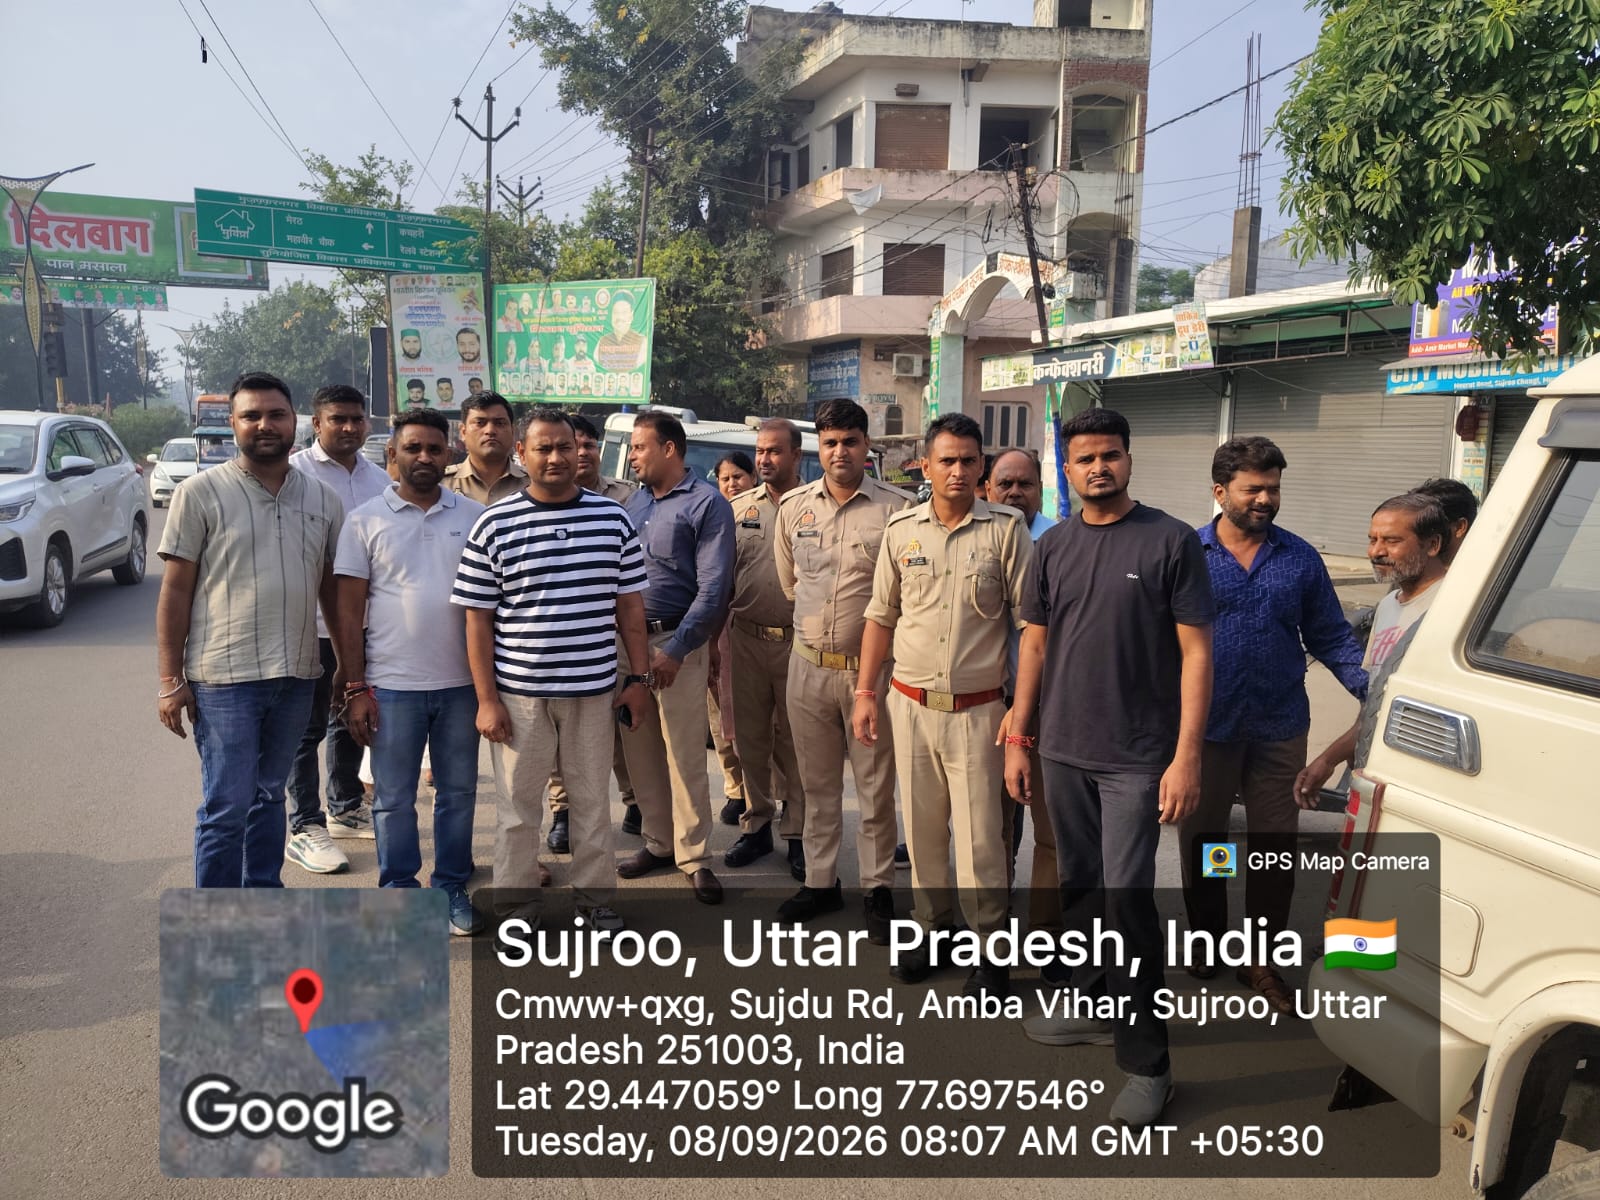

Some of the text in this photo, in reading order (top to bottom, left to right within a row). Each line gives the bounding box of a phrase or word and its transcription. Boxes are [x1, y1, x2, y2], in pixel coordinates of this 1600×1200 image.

[306, 201, 337, 212] विकास
[286, 214, 303, 225] मेरठ
[9, 203, 150, 253] दिलबाग
[400, 228, 424, 239] कचहरी
[287, 233, 313, 245] महावीर
[316, 252, 347, 263] विकास
[400, 245, 441, 258] रेलवे स्टेशन
[46, 258, 128, 273] पान मसाला
[1033, 351, 1105, 381] कन्फेक्शनरी
[1391, 366, 1432, 383] CITY
